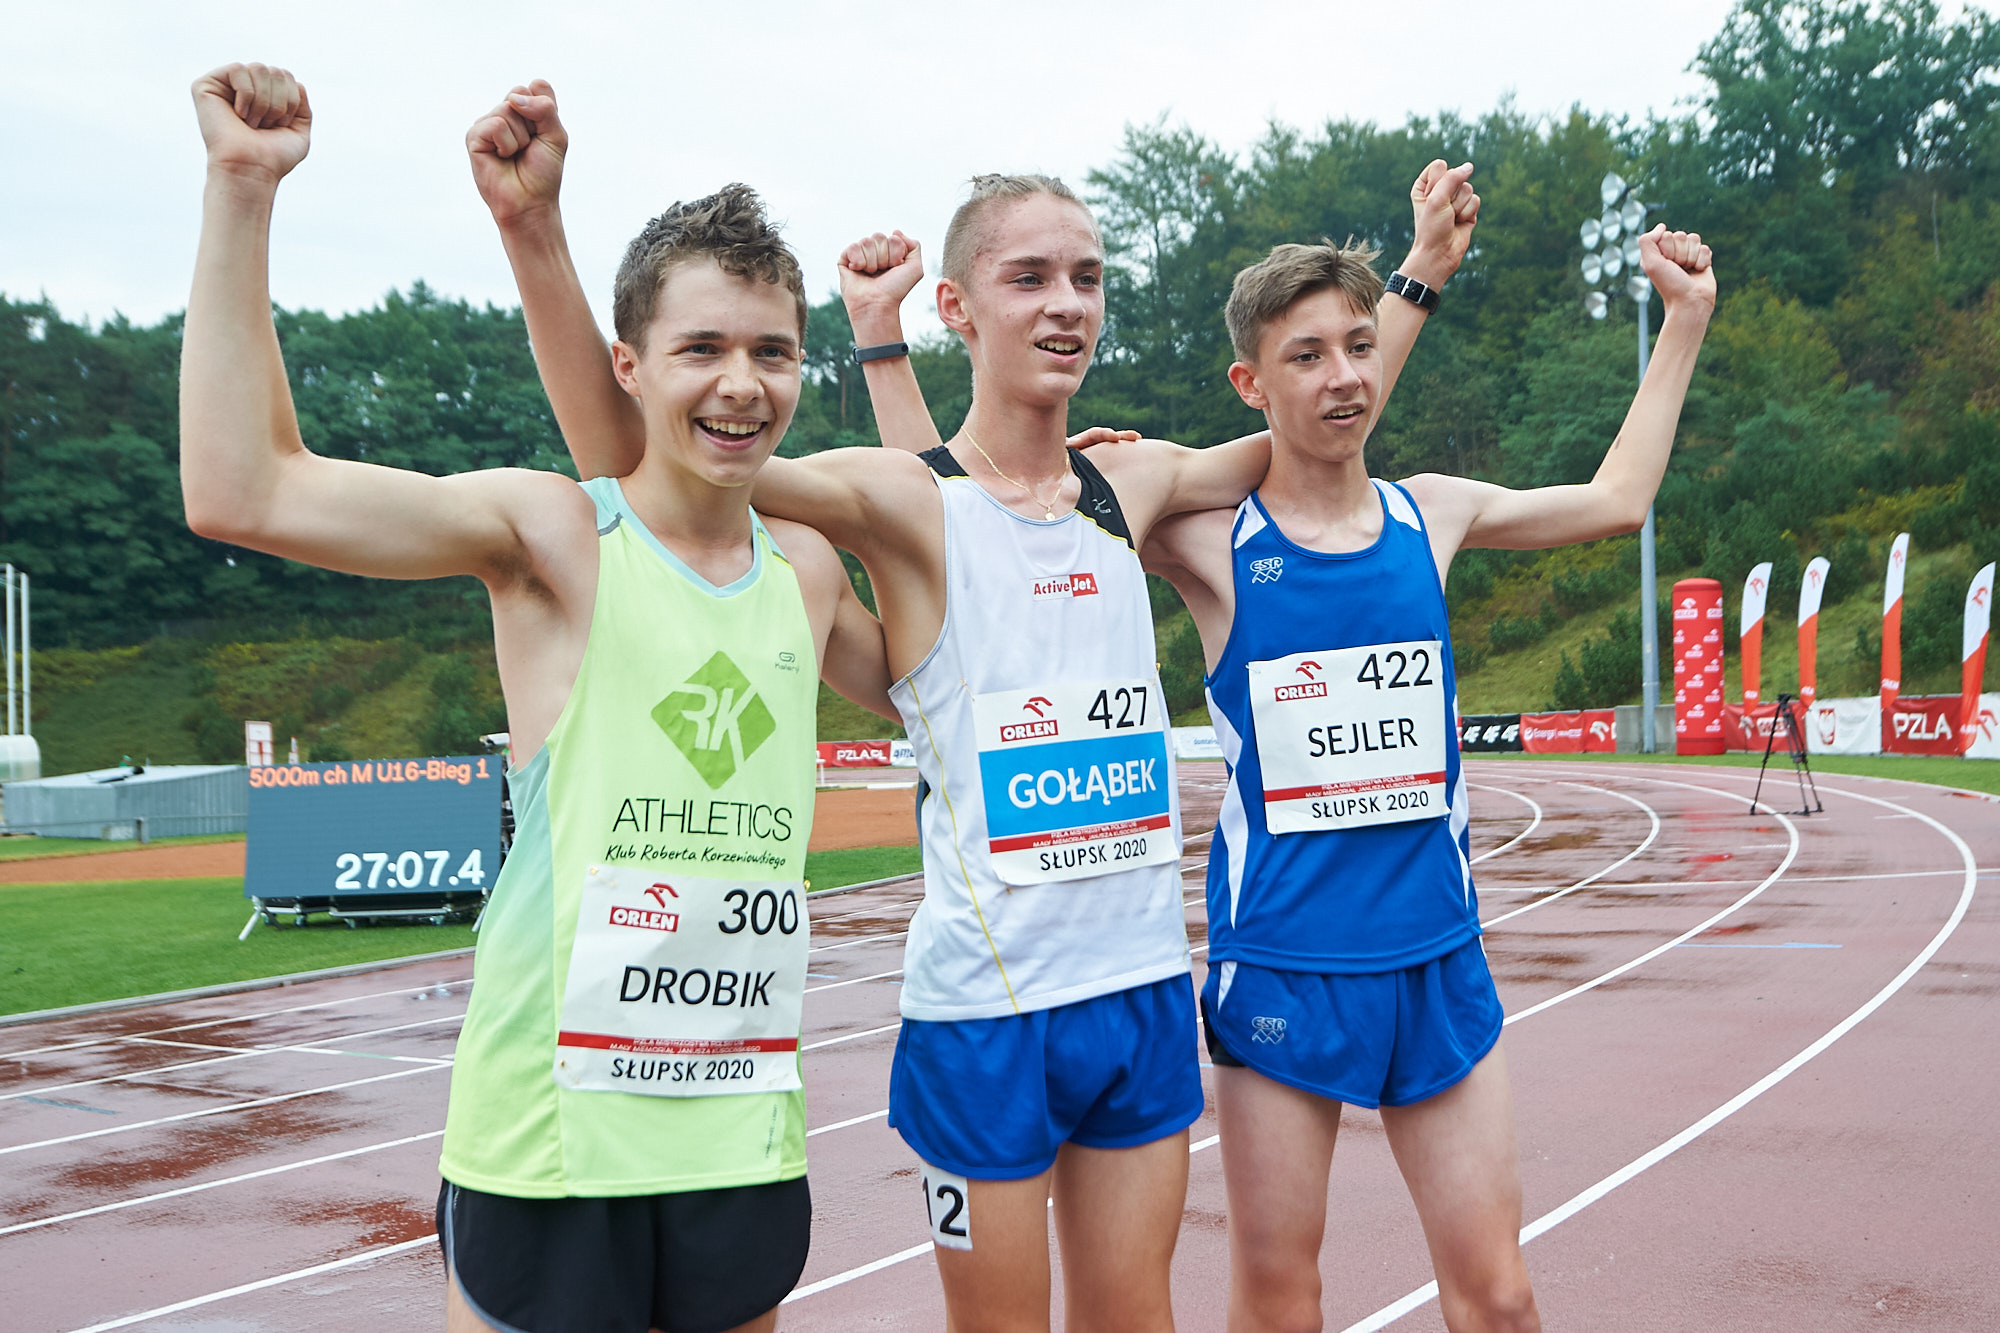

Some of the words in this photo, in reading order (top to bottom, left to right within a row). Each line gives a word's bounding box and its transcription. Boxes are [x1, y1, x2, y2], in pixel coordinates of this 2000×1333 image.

[1357, 649, 1433, 690] 422
[1087, 686, 1147, 730] 427
[1275, 683, 1325, 701] ORLEN
[672, 683, 758, 770] RK
[1002, 721, 1056, 741] ORLEN
[1308, 718, 1418, 757] SEJLER
[1463, 725, 1481, 743] 4F
[1482, 725, 1501, 743] 4F
[1501, 724, 1520, 742] 4F
[1893, 713, 1952, 740] PZLA
[249, 766, 320, 788] 5000m
[323, 764, 348, 785] ch
[351, 763, 373, 783] M
[376, 760, 471, 785] U16-Bieg
[476, 758, 490, 778] 1
[1008, 758, 1156, 809] GOŁĄBEK
[612, 798, 792, 841] ATHLETICS
[1312, 795, 1381, 818] SŁUPSK
[1386, 790, 1429, 811] 2020
[335, 849, 485, 890] 27:07.4
[605, 845, 636, 862] Klub
[641, 845, 697, 862] Roberta
[701, 847, 786, 869] Korzeniowskiego
[1040, 844, 1107, 871] SŁUPSK
[1114, 838, 1147, 860] 2020
[612, 908, 677, 930] ORLEN
[718, 889, 799, 935] 300
[619, 965, 776, 1007] DROBIK
[611, 1057, 699, 1081] SŁUPSK
[705, 1058, 754, 1080] 2020
[922, 1175, 967, 1237] 12
